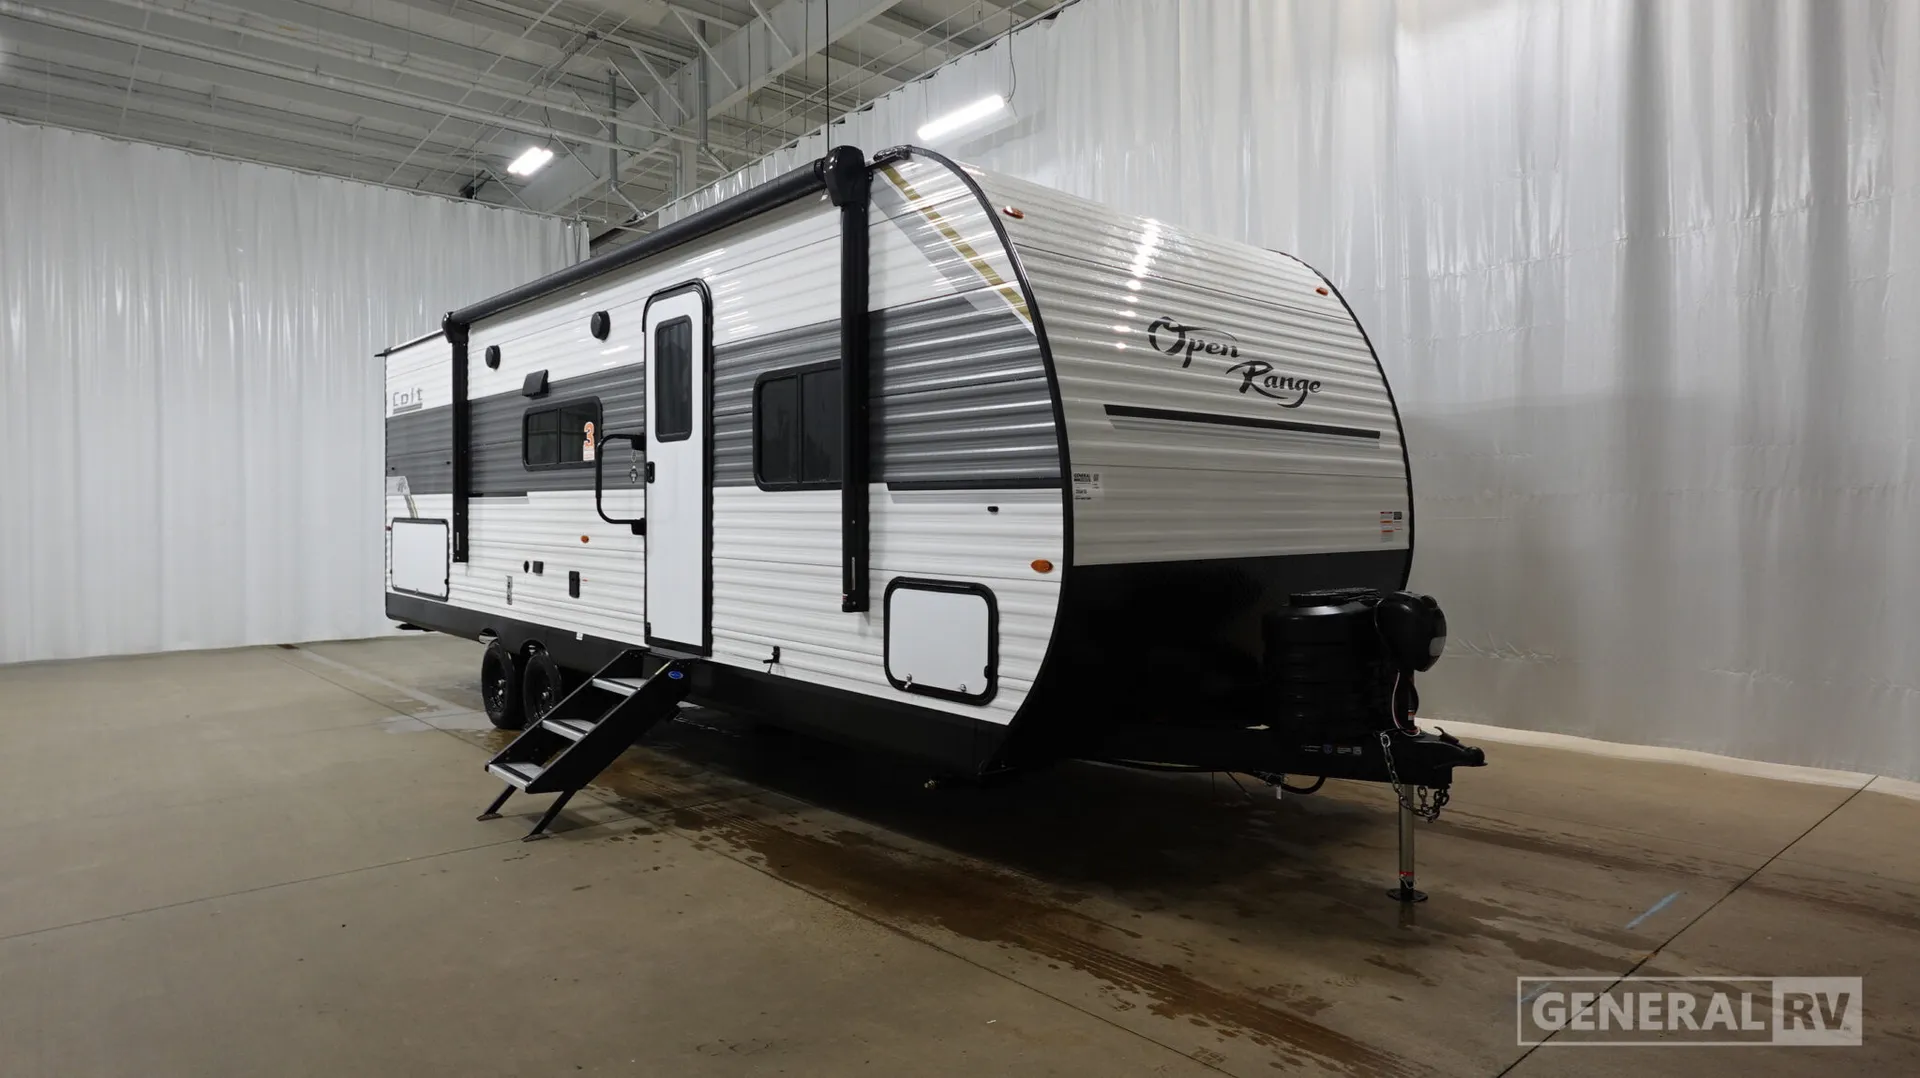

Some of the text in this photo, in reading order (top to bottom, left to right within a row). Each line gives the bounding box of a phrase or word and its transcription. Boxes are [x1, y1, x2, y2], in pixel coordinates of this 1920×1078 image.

[1148, 316, 1240, 368] Open
[393, 388, 422, 407] Colt
[1225, 360, 1321, 408] Range
